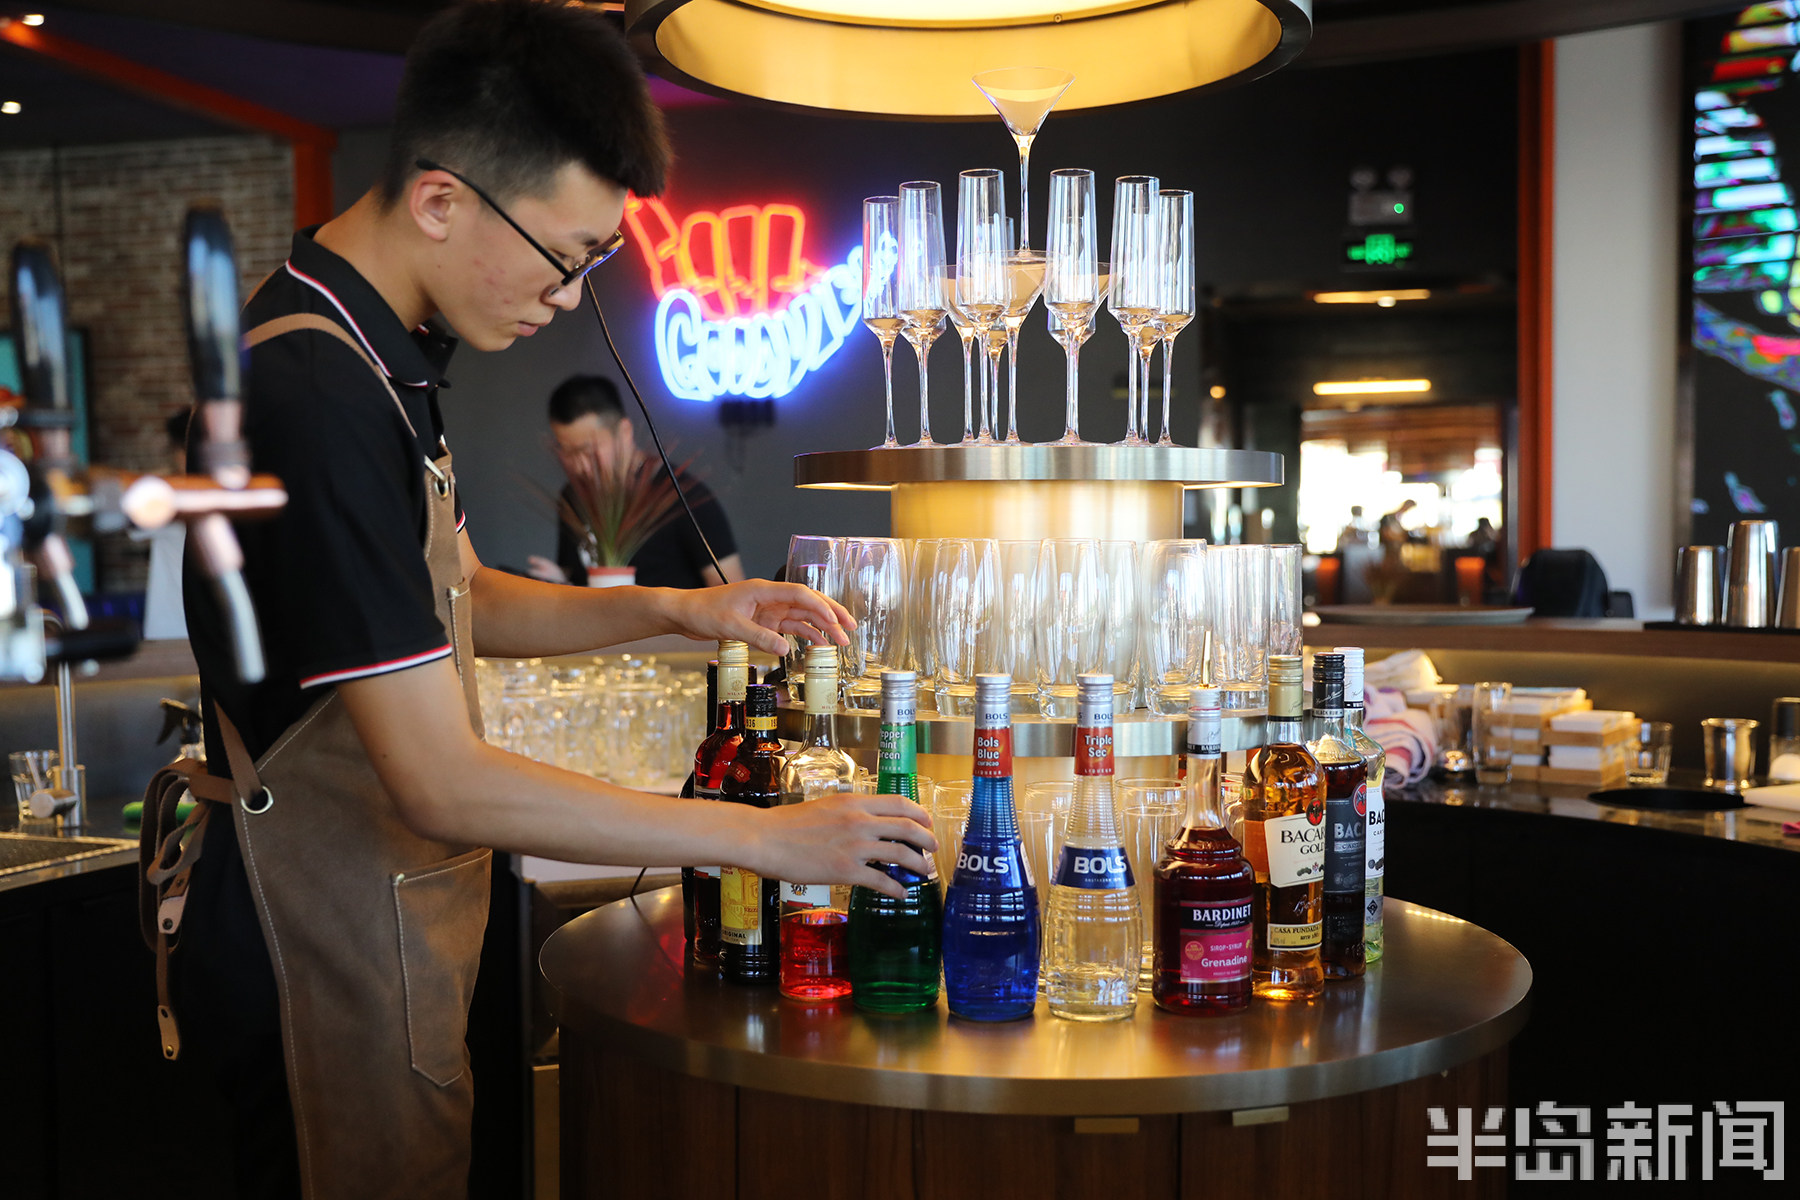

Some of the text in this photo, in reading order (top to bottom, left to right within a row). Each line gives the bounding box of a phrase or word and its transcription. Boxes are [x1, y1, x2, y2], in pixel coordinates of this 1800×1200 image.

[977, 736, 999, 748] Bols
[1084, 734, 1112, 749] Triple
[977, 748, 1000, 759] Blue
[1088, 746, 1107, 758] Sec
[956, 852, 1010, 874] BOLS
[1073, 855, 1128, 874] BOLS
[1192, 903, 1252, 922] BARDINET
[1201, 955, 1248, 968] Grenadine
